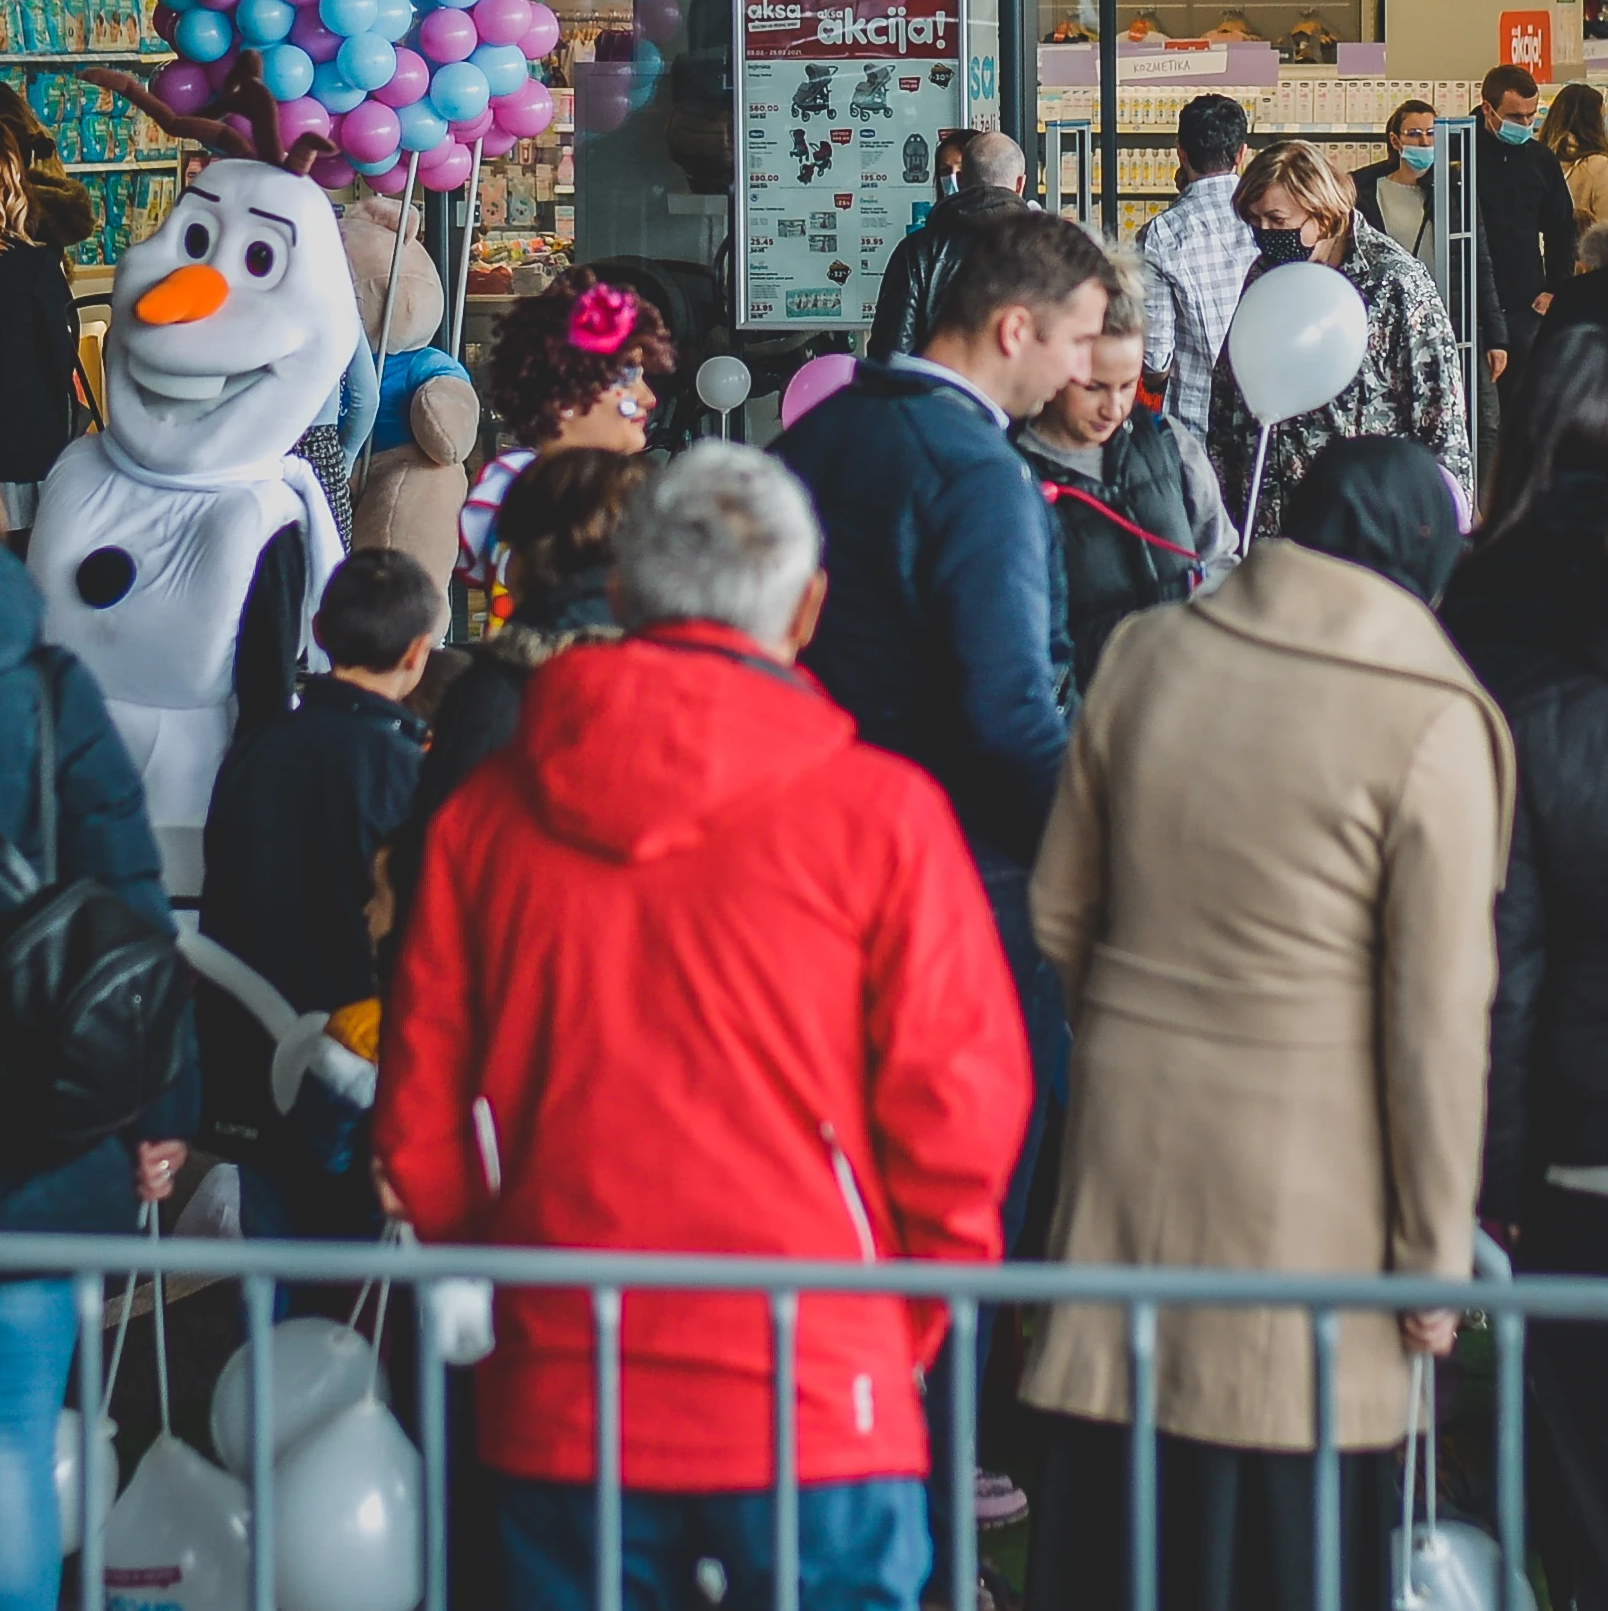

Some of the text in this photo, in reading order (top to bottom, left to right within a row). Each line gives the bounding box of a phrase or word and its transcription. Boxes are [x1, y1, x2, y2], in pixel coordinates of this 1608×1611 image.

[817, 6, 946, 54] akcija!
[970, 55, 995, 100] sa
[1133, 59, 1191, 73] KOZMETIKA
